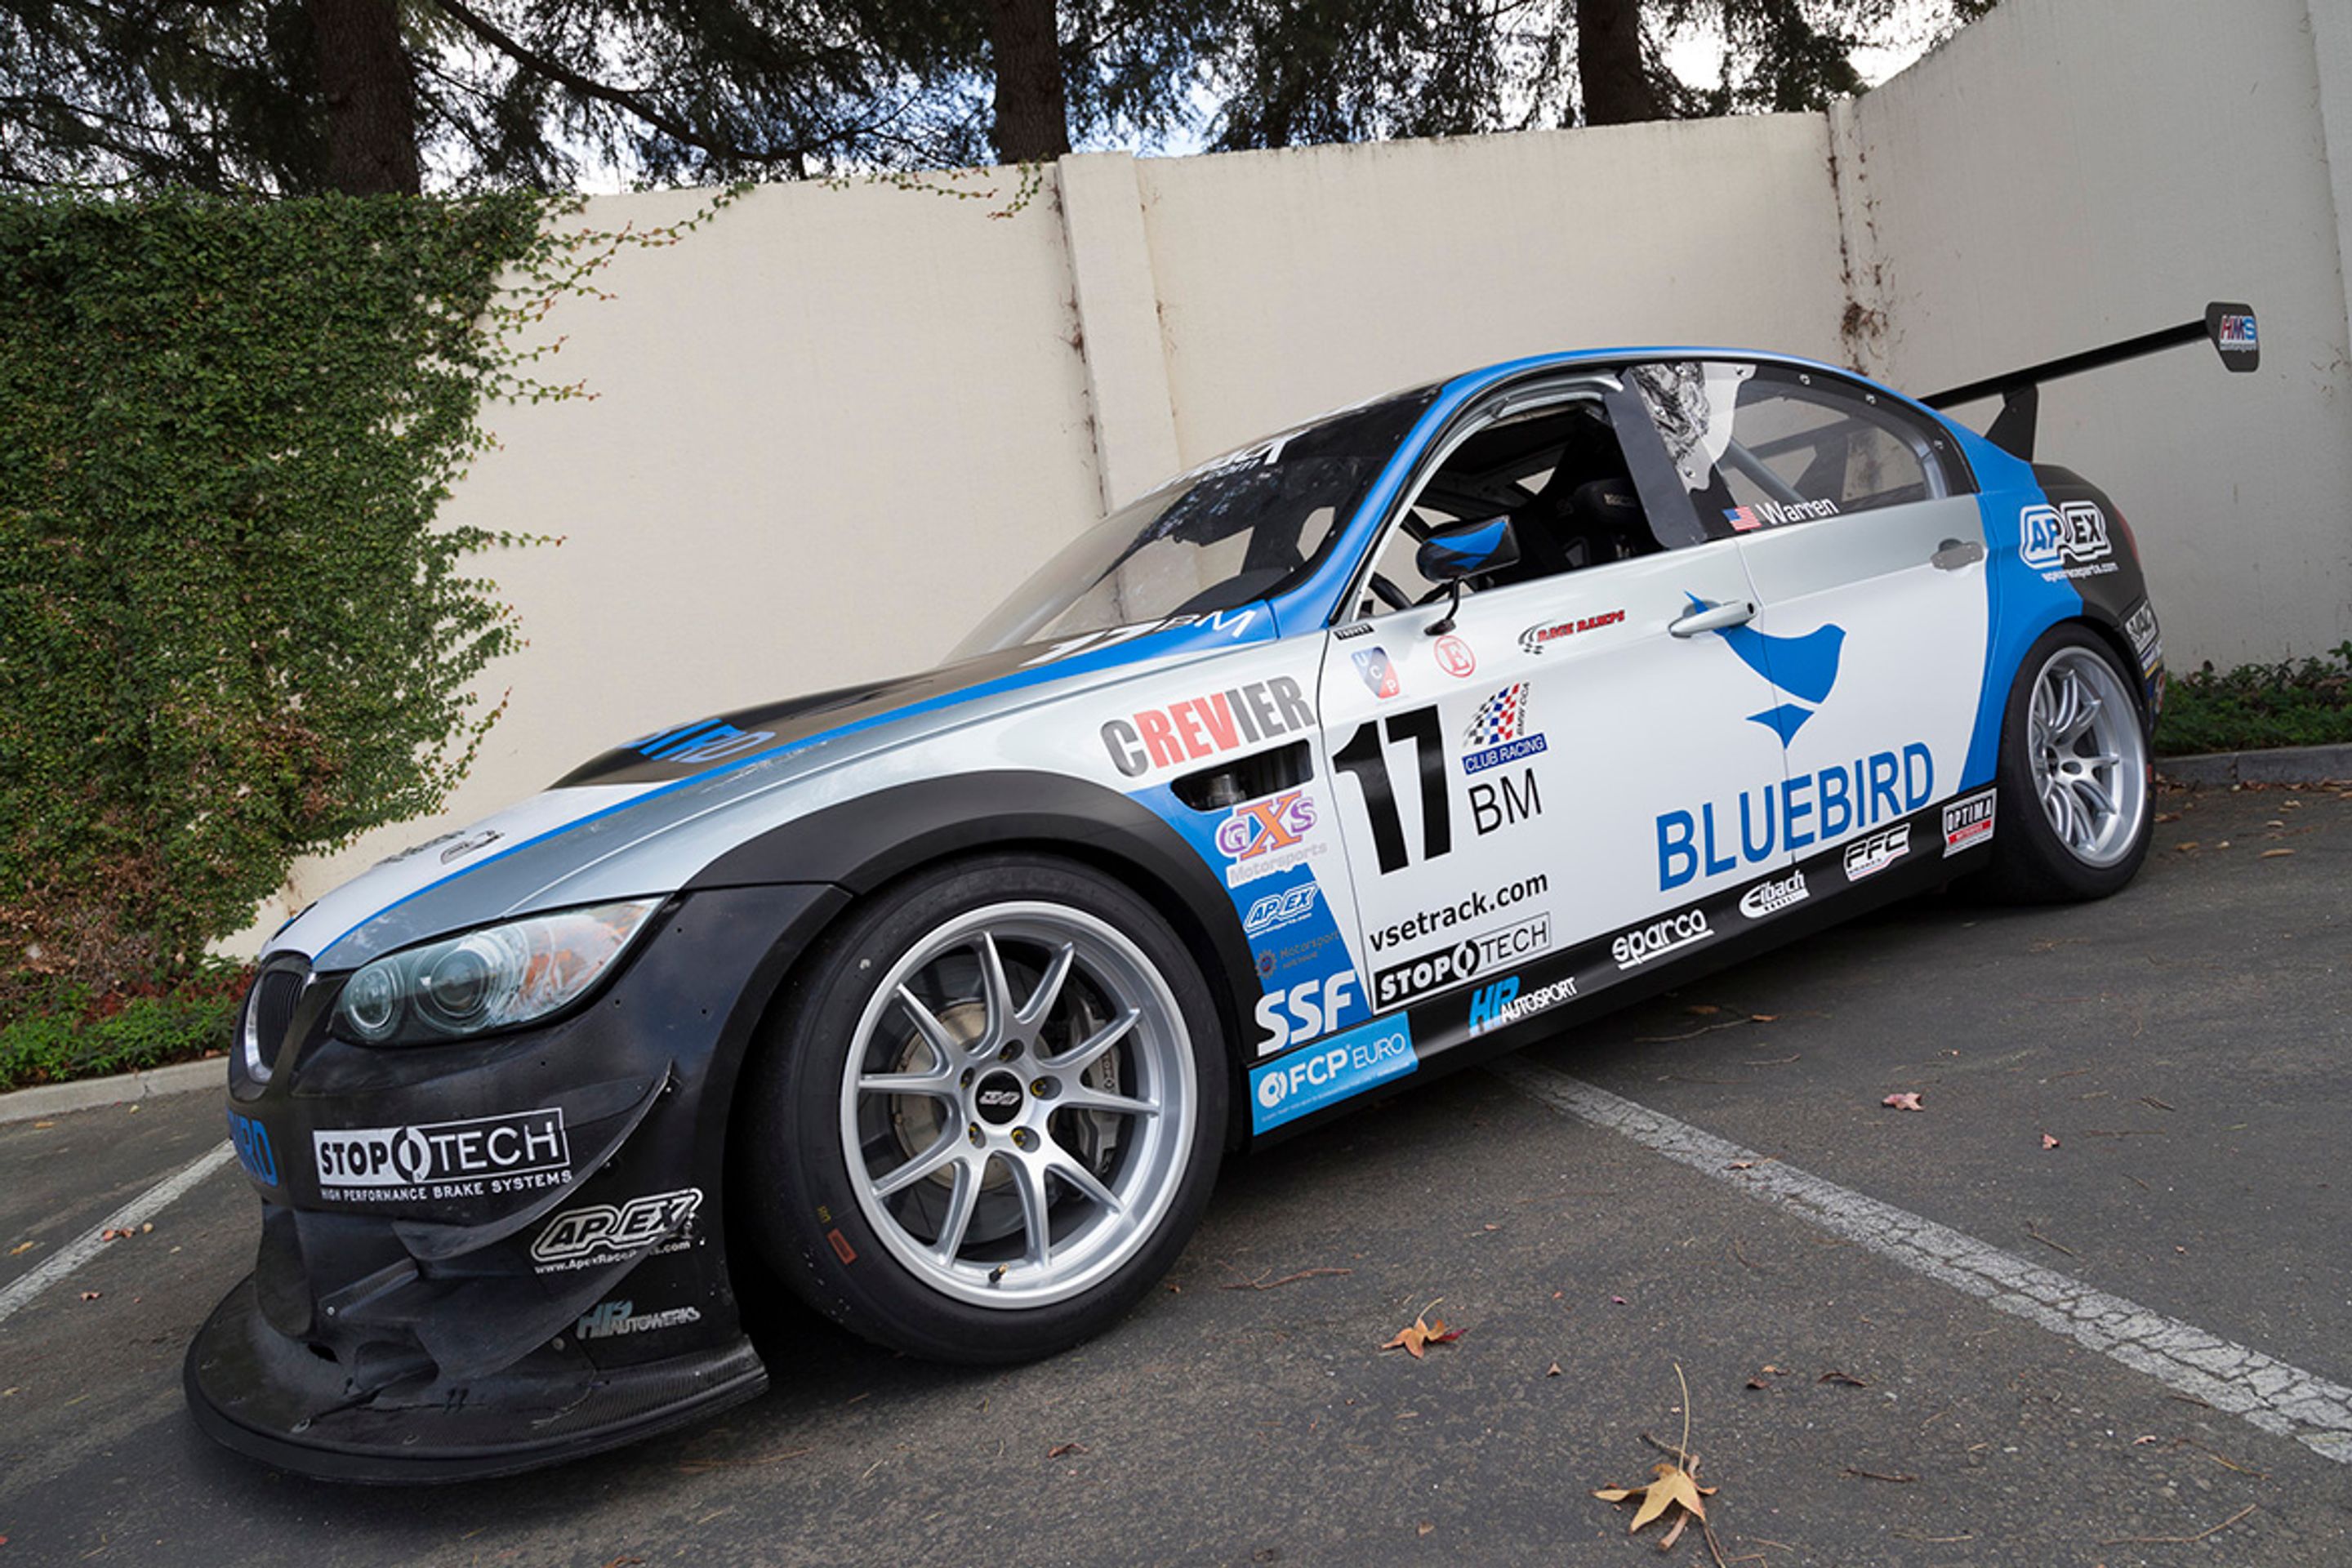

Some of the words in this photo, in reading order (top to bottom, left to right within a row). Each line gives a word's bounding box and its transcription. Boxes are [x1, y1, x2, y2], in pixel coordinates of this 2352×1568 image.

[1757, 496, 1840, 525] Warren
[2025, 506, 2109, 561] APEX
[1537, 621, 1575, 643] RACE
[1099, 675, 1317, 777] CREVIER
[1465, 749, 1499, 772] CLUB
[1499, 736, 1545, 761] RACING
[1332, 704, 1452, 876] 17
[1468, 768, 1543, 836] BM
[1947, 796, 1993, 834] OPTIMA
[1655, 742, 1935, 892] BLUEBIRD
[1228, 842, 1329, 885] Motorsports
[1846, 826, 1909, 869] PFC
[1247, 882, 1318, 929] APEX
[1369, 872, 1548, 952] vsetrack.com
[1611, 908, 1709, 964] sparco
[1254, 969, 1356, 1057] SSF
[1499, 977, 1578, 1023] AUTOSPORT
[1290, 1049, 1348, 1095] FCP
[1352, 1032, 1406, 1070] EURO
[343, 1187, 427, 1201] PERFORMANCE
[433, 1183, 484, 1199] BRAKE
[492, 1169, 572, 1193] SYSTEMS
